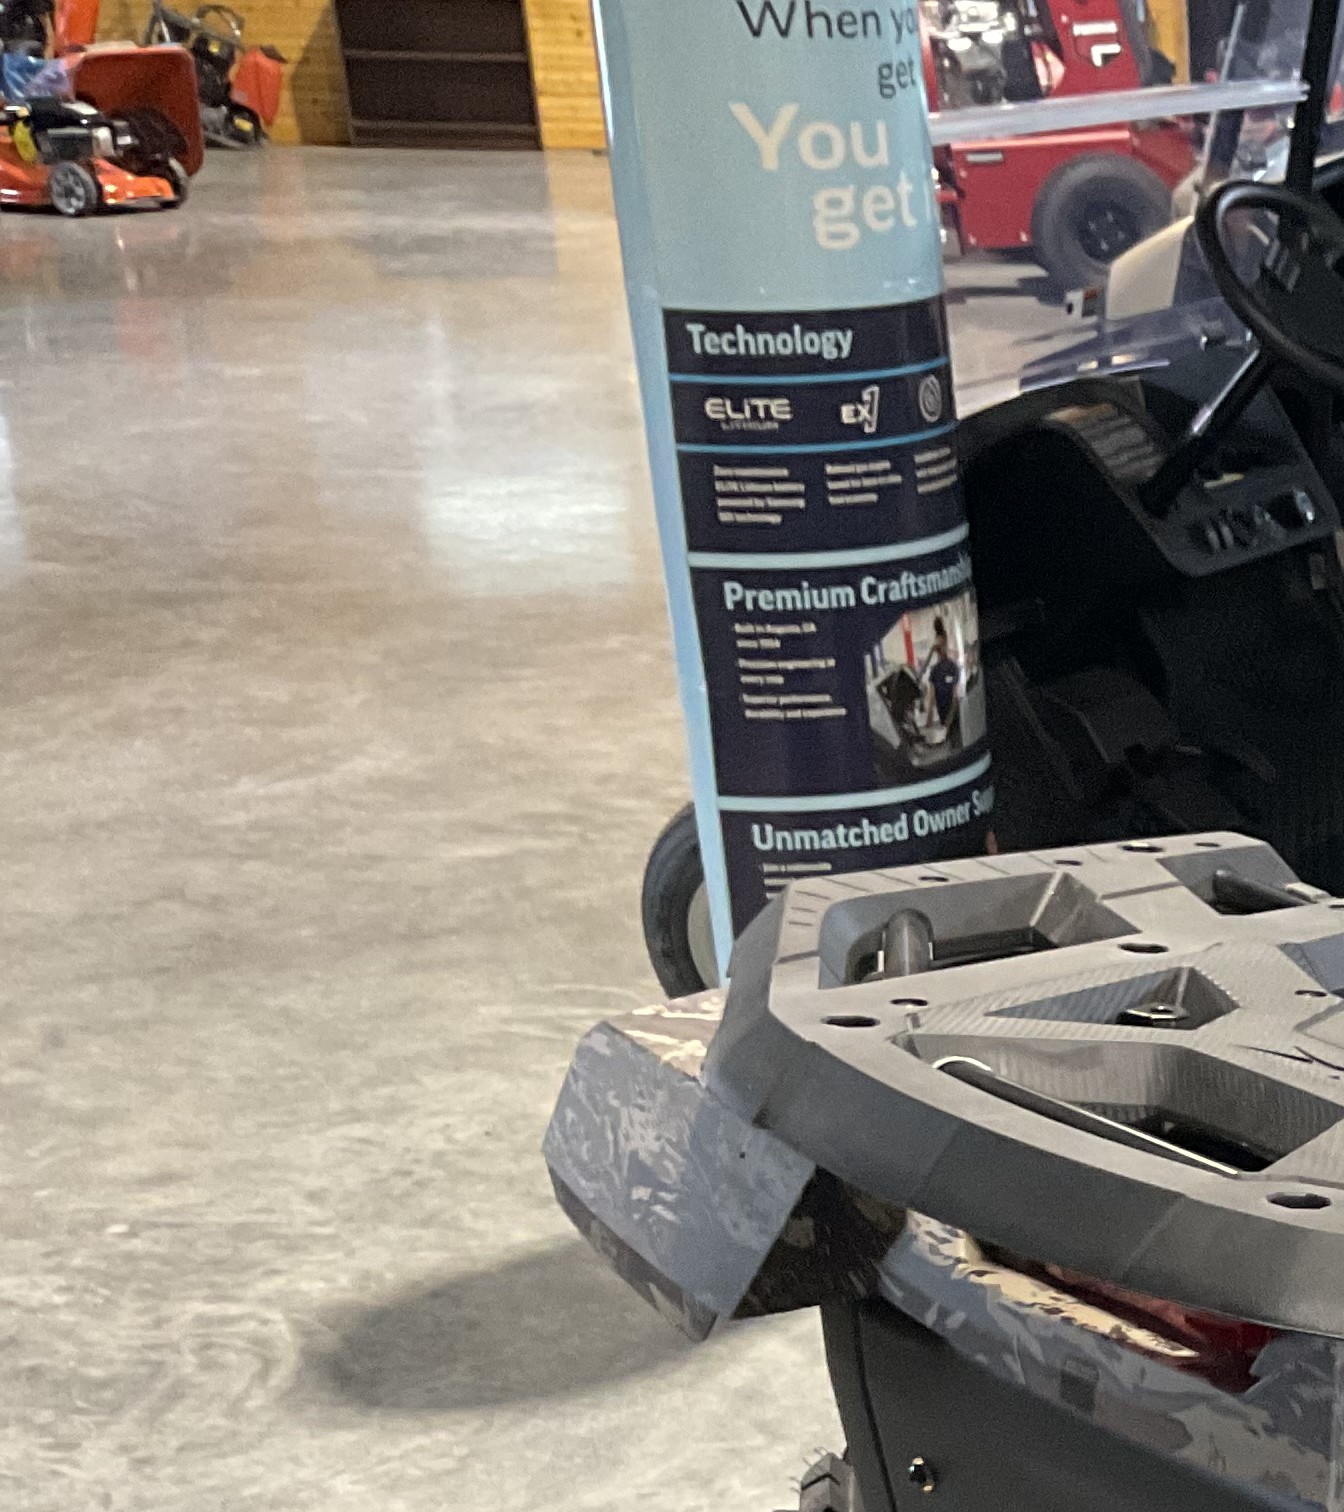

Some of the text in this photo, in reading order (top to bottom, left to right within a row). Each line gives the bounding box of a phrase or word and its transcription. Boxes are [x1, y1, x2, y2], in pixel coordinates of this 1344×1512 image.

[736, 0, 883, 38] When
[878, 57, 917, 99] get
[729, 101, 890, 172] You
[812, 168, 918, 250] get
[686, 323, 853, 360] Technology
[704, 397, 793, 421] ELITE
[723, 580, 857, 612] Premium
[752, 801, 971, 852] Unmatched Owner
